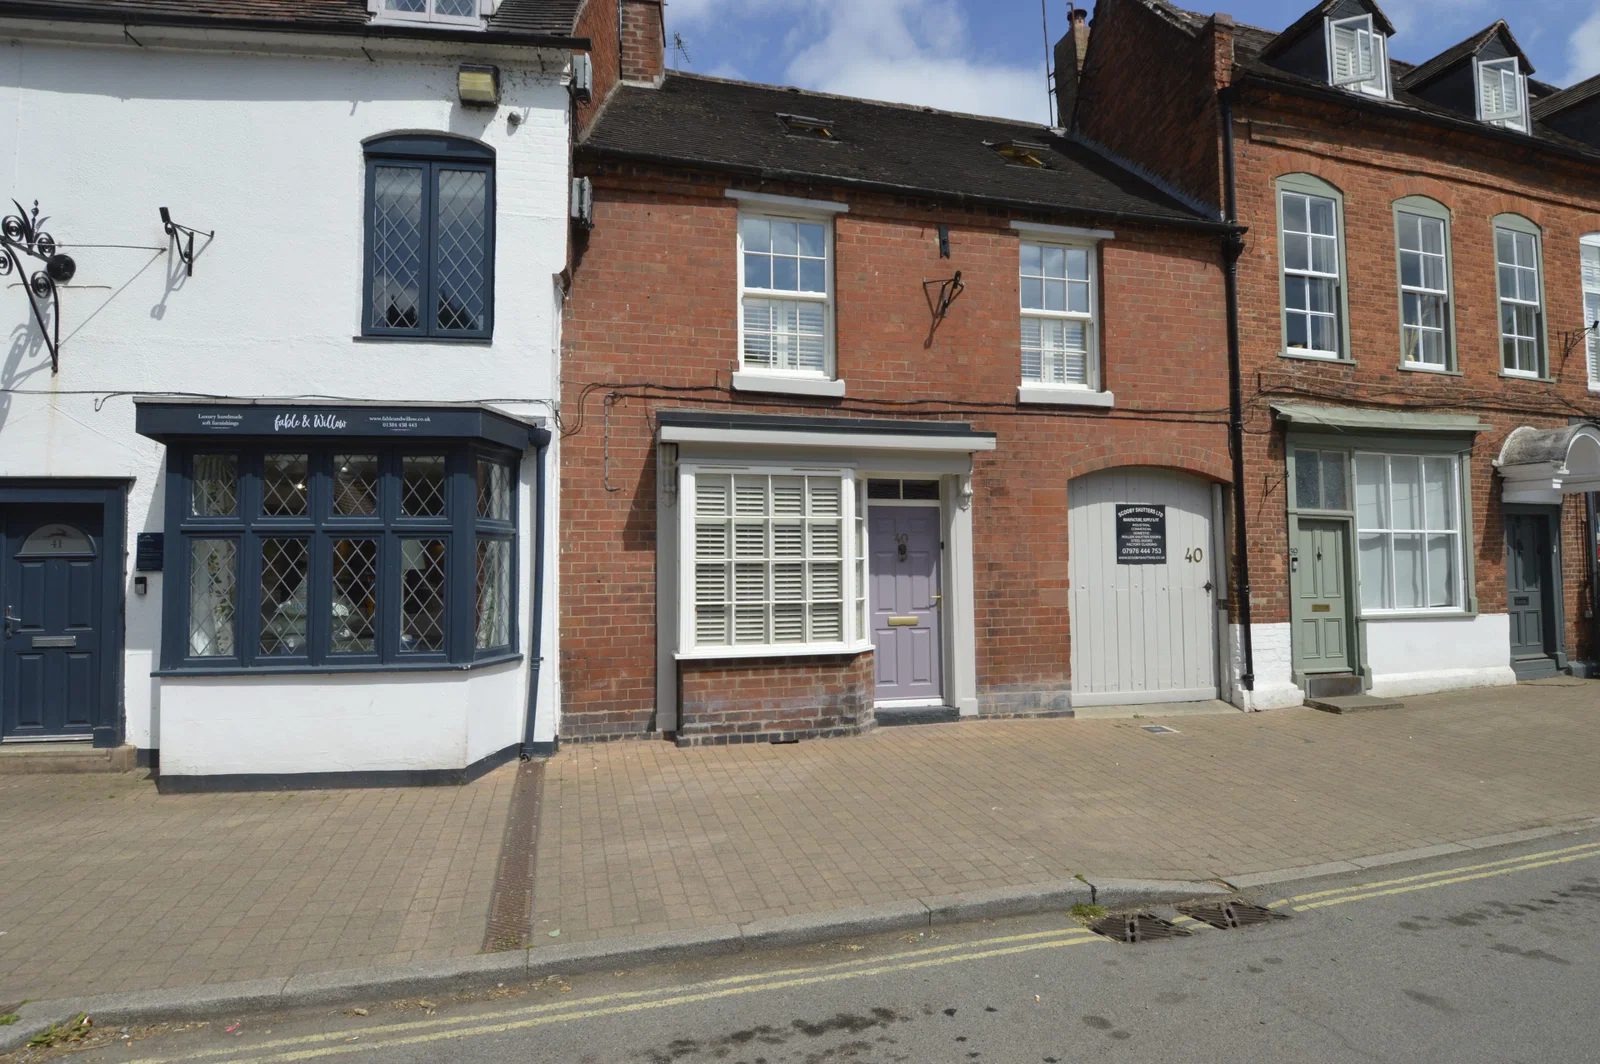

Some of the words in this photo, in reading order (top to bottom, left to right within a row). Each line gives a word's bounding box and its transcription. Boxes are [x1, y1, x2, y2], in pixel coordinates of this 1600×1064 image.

[302, 414, 310, 428] &
[313, 414, 347, 429] Willow
[1118, 507, 1135, 517] SCOOBY
[1155, 510, 1164, 518] LTD
[1185, 547, 1203, 563] 40
